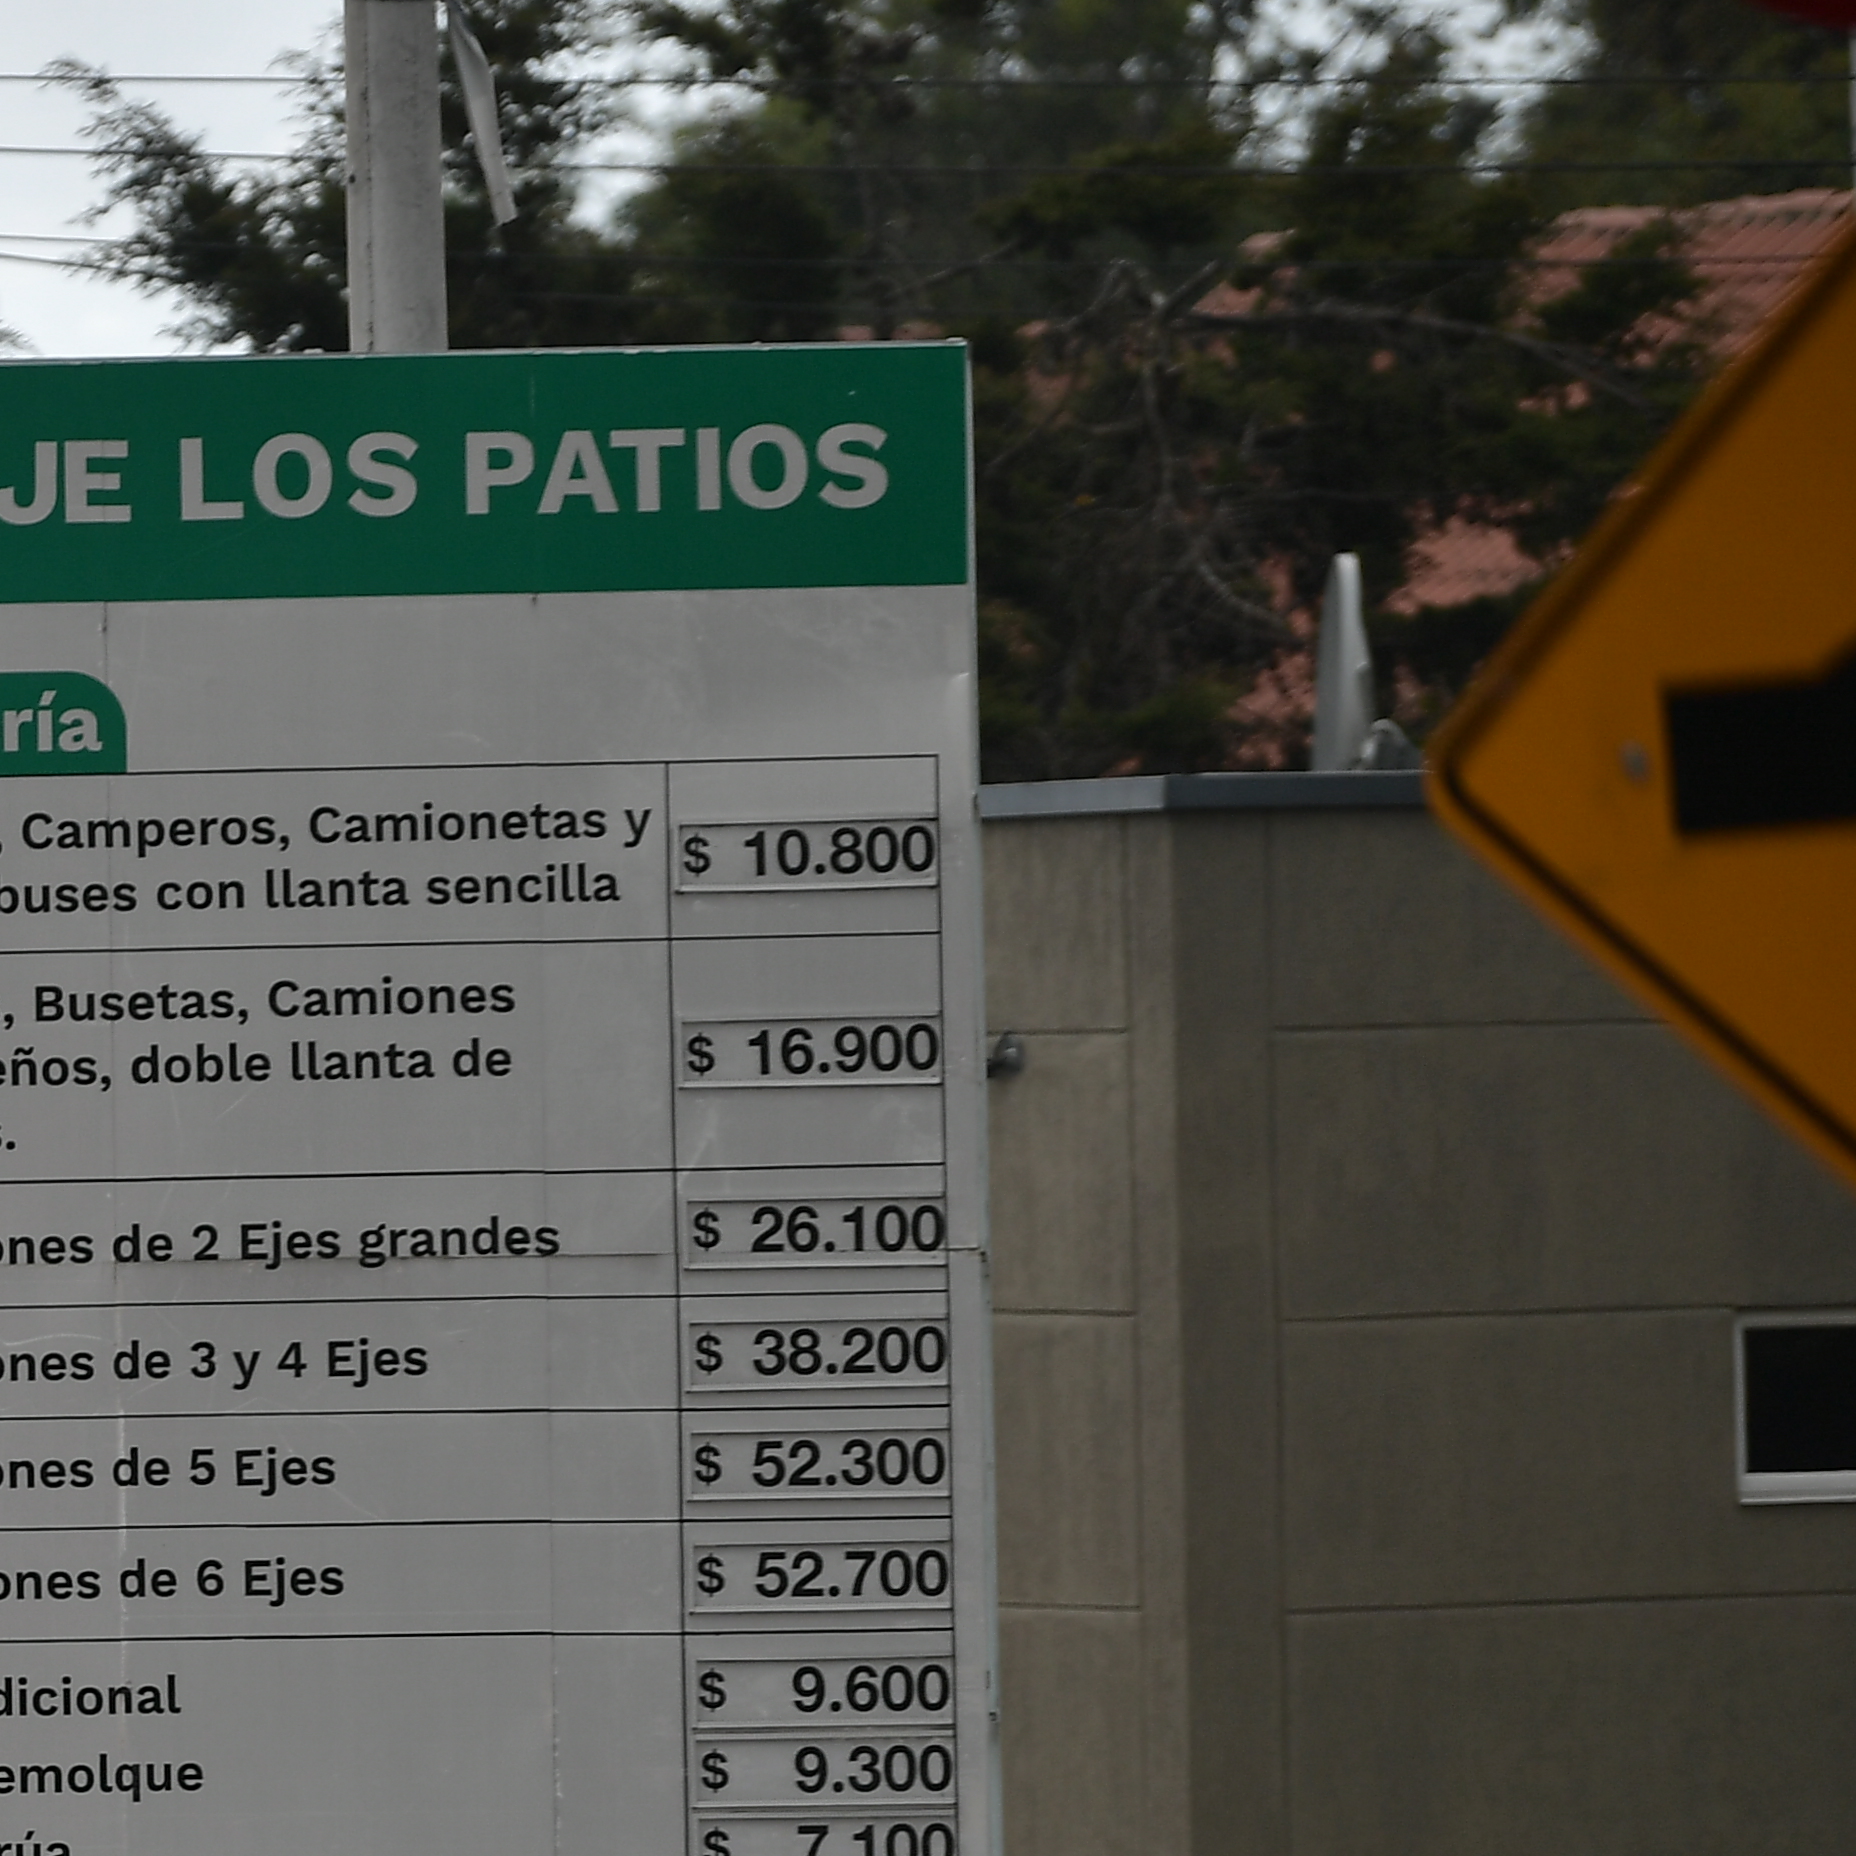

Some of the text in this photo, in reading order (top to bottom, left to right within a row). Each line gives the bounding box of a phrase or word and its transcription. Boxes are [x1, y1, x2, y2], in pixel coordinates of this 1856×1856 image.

[181, 432, 418, 520] LOS
[466, 424, 887, 514] PATIOS
[23, 813, 289, 858] Camperos,
[310, 802, 606, 843] Camionetas
[624, 809, 651, 848] y
[684, 825, 935, 876] $ 10.800
[157, 881, 244, 910] con
[266, 869, 409, 908] llanta
[427, 863, 620, 904] sencilla
[35, 985, 248, 1025] Busetas,
[269, 976, 515, 1017] Camiones
[132, 1043, 270, 1084] doble
[292, 1041, 434, 1080] llanta
[453, 1038, 511, 1077] de
[687, 1023, 945, 1076] $ 16.900
[113, 1224, 172, 1263] de
[193, 1225, 218, 1261] 2
[241, 1221, 340, 1270] Ejes
[359, 1216, 559, 1268] grandes
[693, 1205, 947, 1252] $ 26.100
[114, 1340, 170, 1379] de
[191, 1342, 215, 1378] 3
[233, 1351, 260, 1390] y
[278, 1342, 307, 1377] 4
[328, 1338, 427, 1387] Ejes
[696, 1326, 951, 1381] $ 38.200
[113, 1447, 170, 1486] de
[190, 1449, 215, 1485] 5
[236, 1447, 335, 1496] Ejes
[694, 1438, 945, 1487] $ 52.300
[121, 1559, 176, 1597] de
[197, 1560, 223, 1596] 6
[245, 1557, 343, 1607] Ejes
[697, 1550, 948, 1598] $ 52.700
[699, 1665, 950, 1712] $ 9.600
[702, 1745, 958, 1797] $ 9.300
